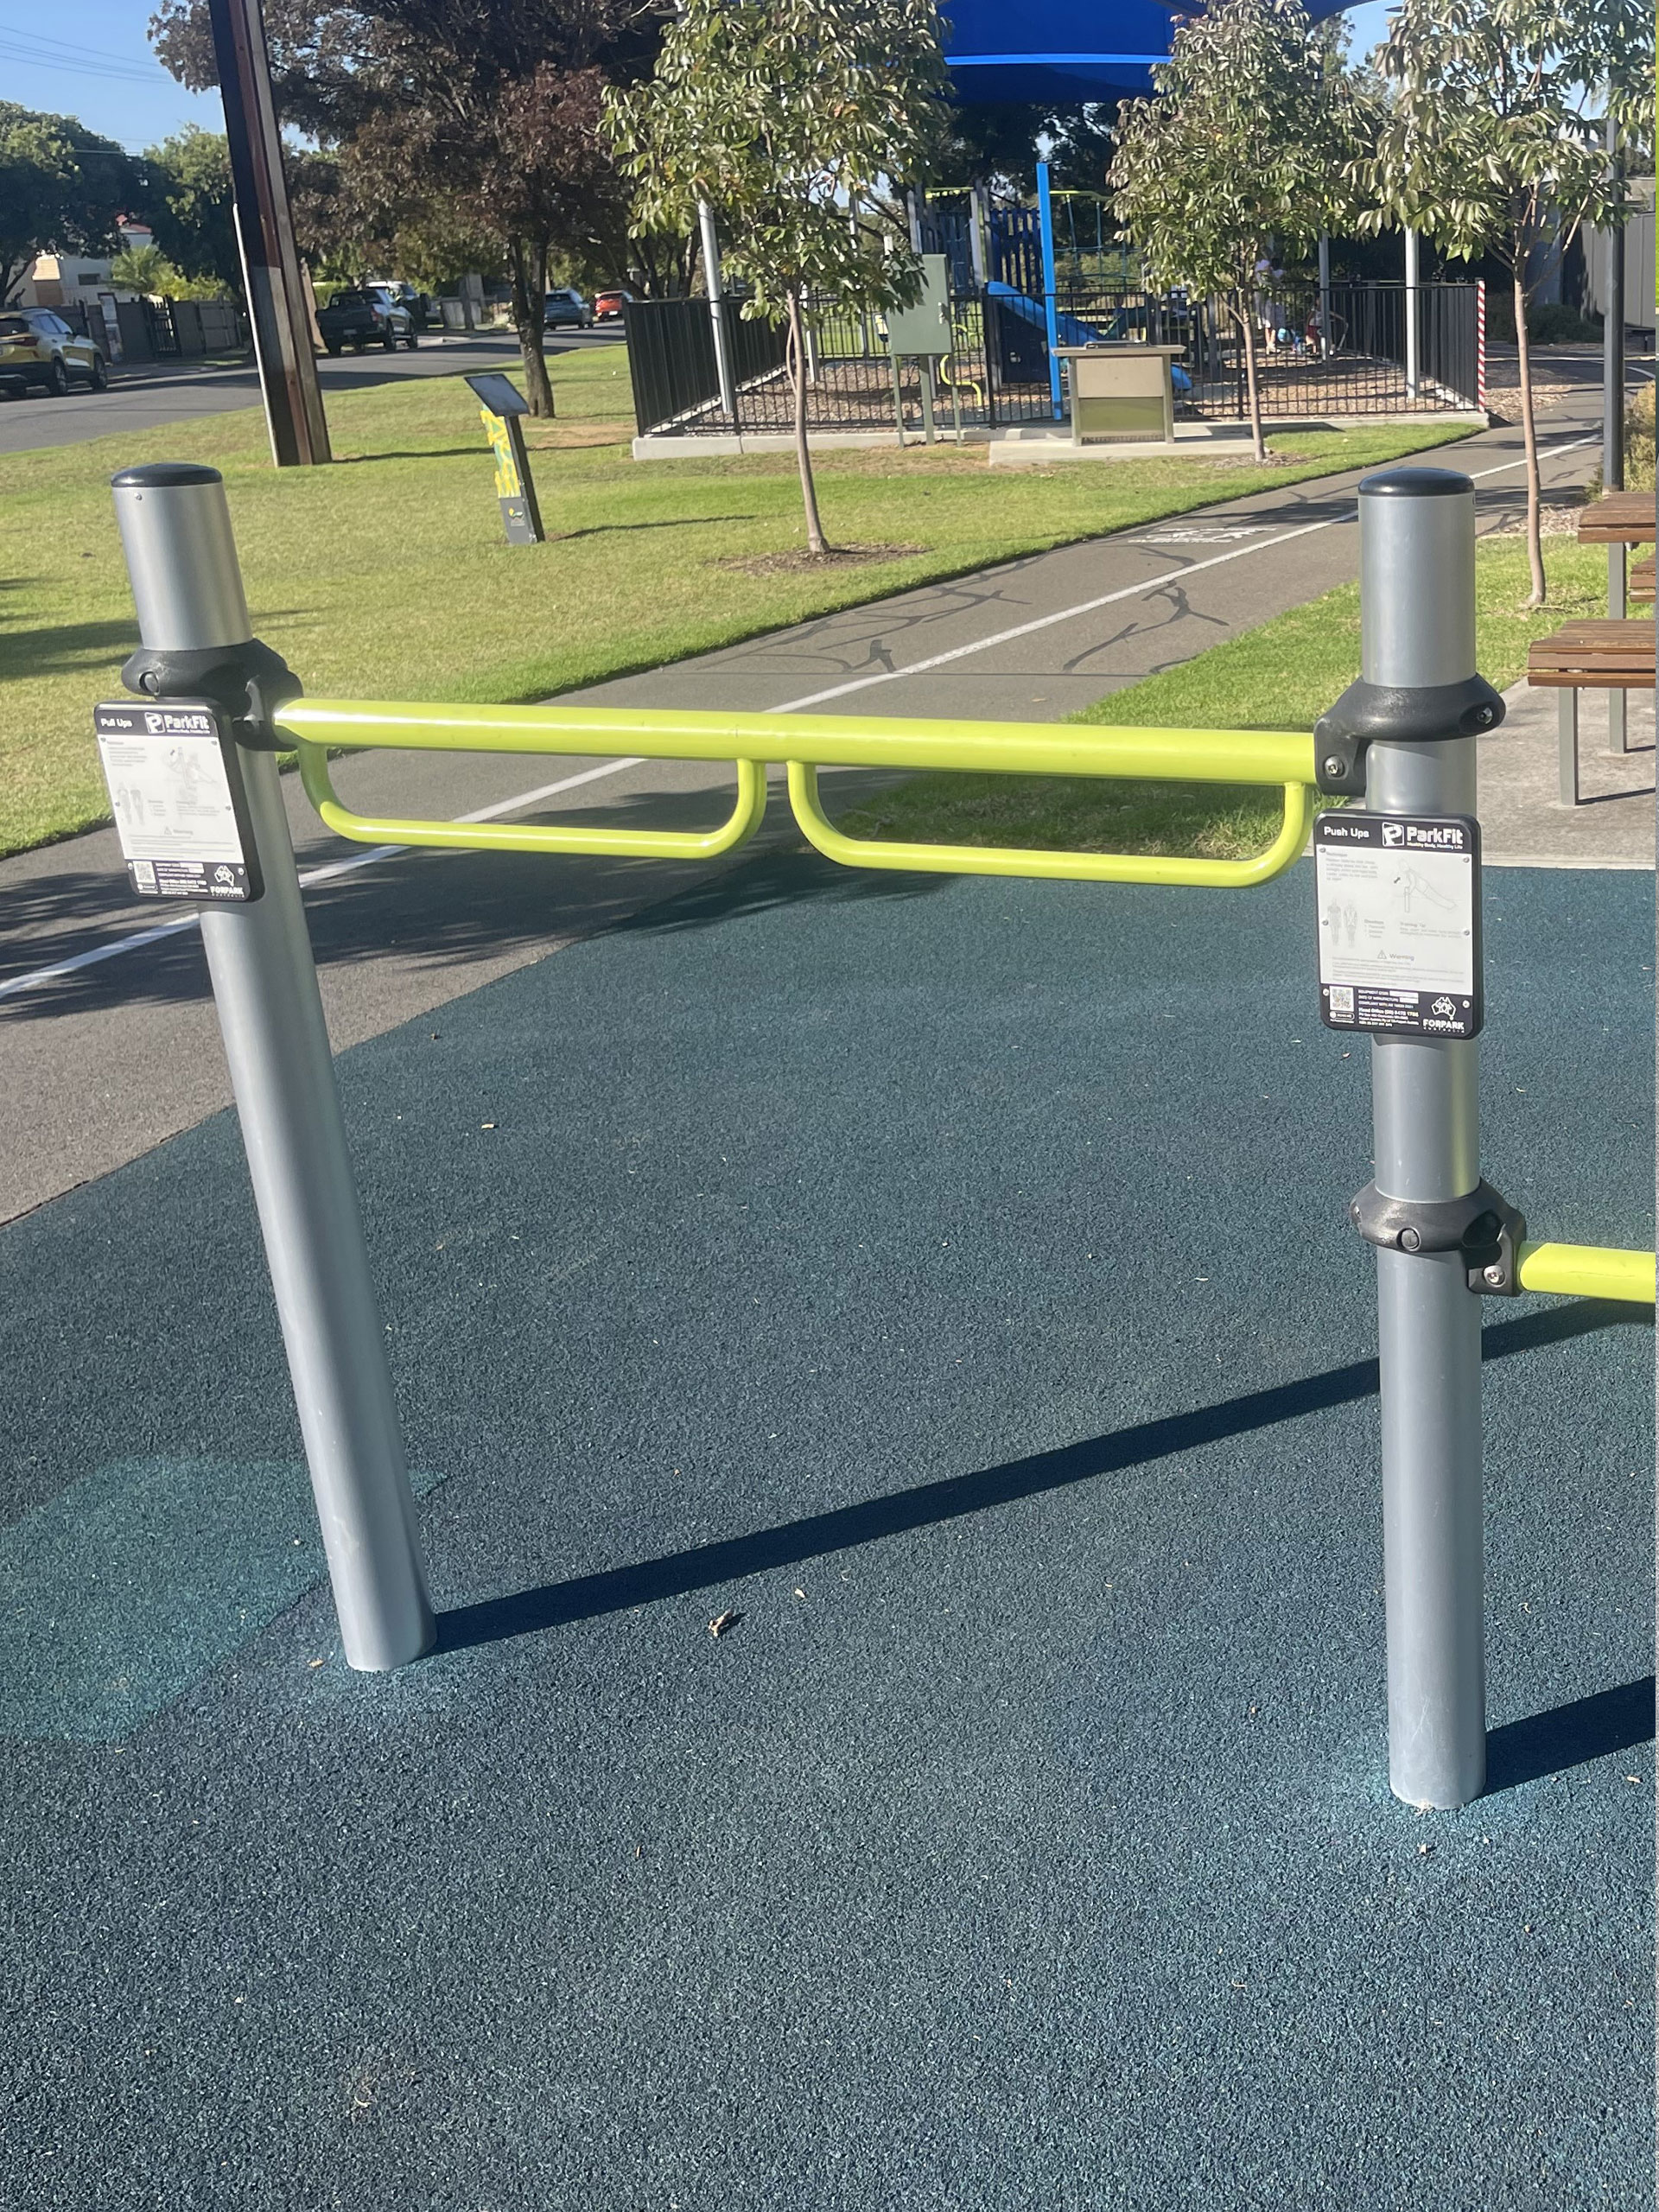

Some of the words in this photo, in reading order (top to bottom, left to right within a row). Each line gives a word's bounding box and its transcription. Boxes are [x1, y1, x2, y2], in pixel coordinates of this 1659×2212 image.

[100, 718, 115, 727] Pull
[117, 718, 133, 728] Ups
[163, 715, 210, 729] ParkFit
[1324, 826, 1348, 837] Push
[1350, 829, 1370, 839] Ups
[1407, 826, 1464, 845] ParkFit
[209, 886, 244, 895] FORPARK
[1422, 1018, 1465, 1030] FORPARK
